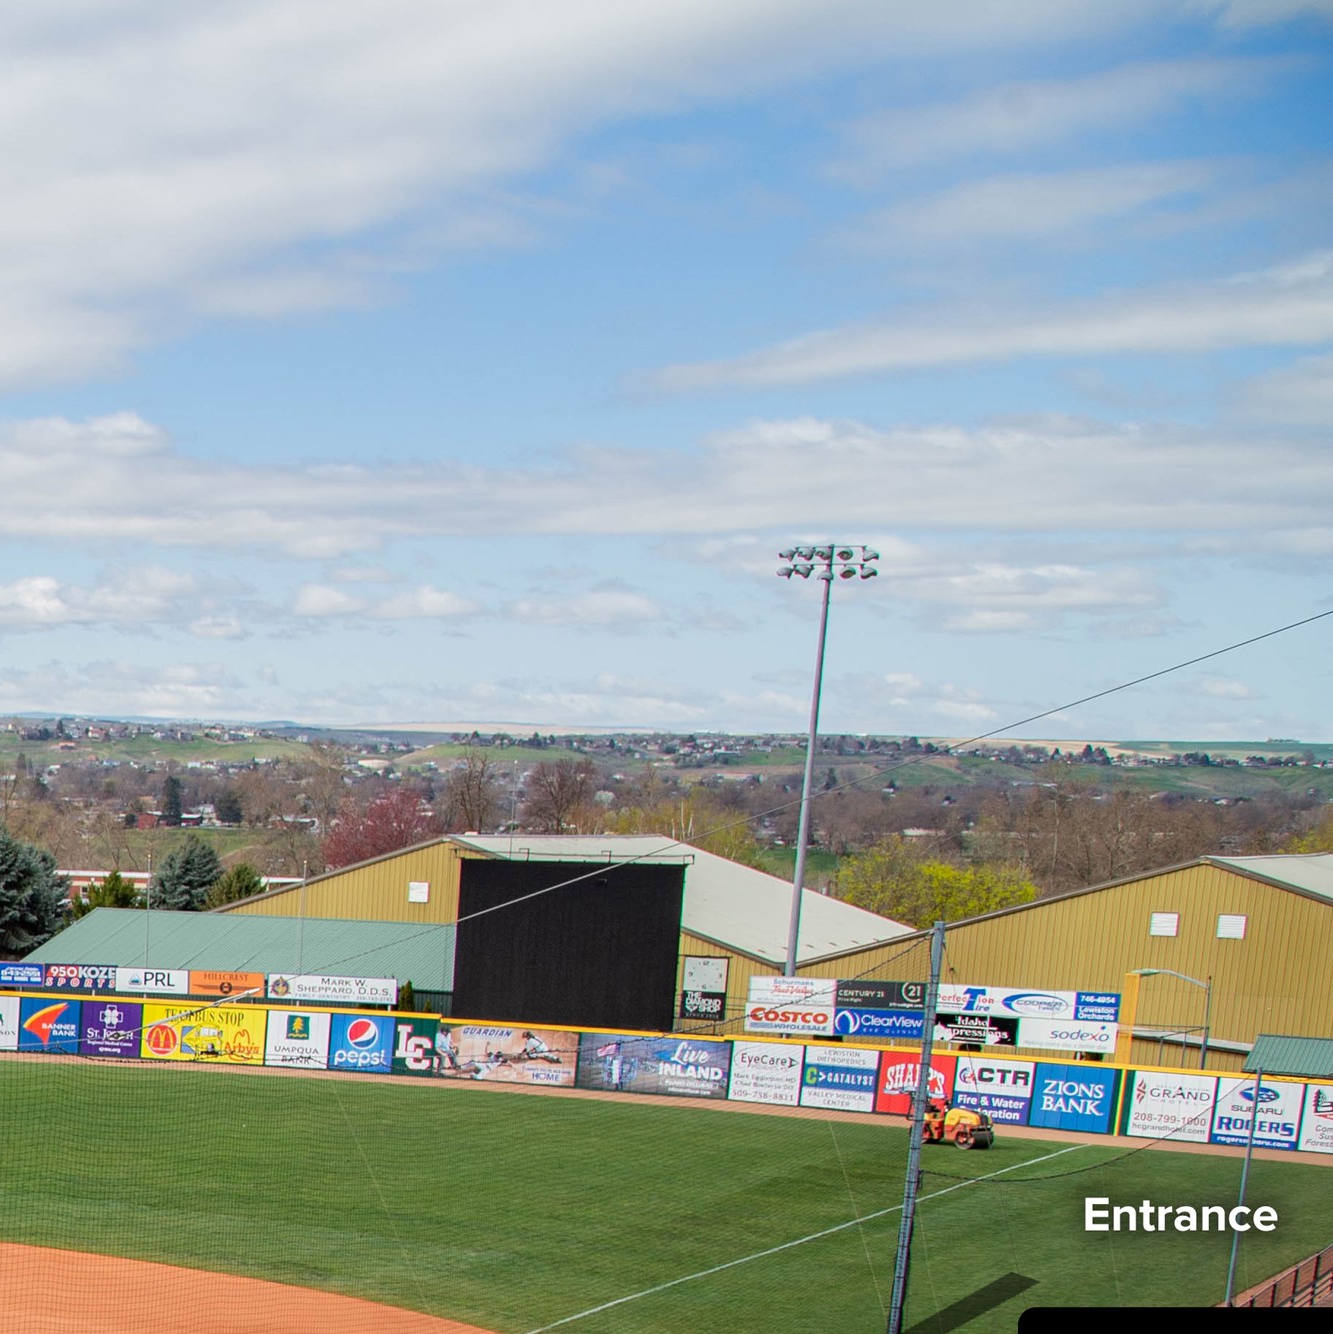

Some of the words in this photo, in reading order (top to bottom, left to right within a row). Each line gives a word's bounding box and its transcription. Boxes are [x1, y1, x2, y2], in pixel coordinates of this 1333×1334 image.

[51, 966, 78, 978] 950
[78, 967, 116, 979] KOZE
[143, 972, 175, 987] PRL
[203, 972, 249, 981] HILLCREST
[45, 977, 117, 988] SPORTS
[321, 977, 351, 986] MARK
[358, 986, 392, 996] D.D.S.
[838, 990, 875, 998] CENTURY
[195, 1010, 215, 1023] BUS
[217, 1011, 245, 1028] STOP
[750, 1006, 829, 1025] COSTCO
[860, 1013, 923, 1028] ClearView
[52, 1029, 76, 1037] BANK
[462, 1026, 513, 1038] GUARDIAN
[773, 1023, 827, 1032] WHOLESALE
[1049, 1025, 1110, 1043] sodexo
[224, 1042, 259, 1055] Arby's
[274, 1045, 319, 1055] UMPQUA
[670, 1041, 711, 1065] Live
[334, 1049, 388, 1066] pepsi
[740, 1052, 787, 1067] EyeCare
[532, 1072, 561, 1082] HOME
[658, 1063, 724, 1081] INLAND
[827, 1071, 874, 1085] CATALYST
[978, 1067, 1031, 1086] CTR
[1042, 1079, 1104, 1099] ZIONS
[1149, 1085, 1210, 1102] GRAND
[957, 1094, 977, 1105] Fire
[979, 1096, 989, 1106] &
[991, 1098, 1025, 1110] Water
[1041, 1095, 1105, 1117] BANK
